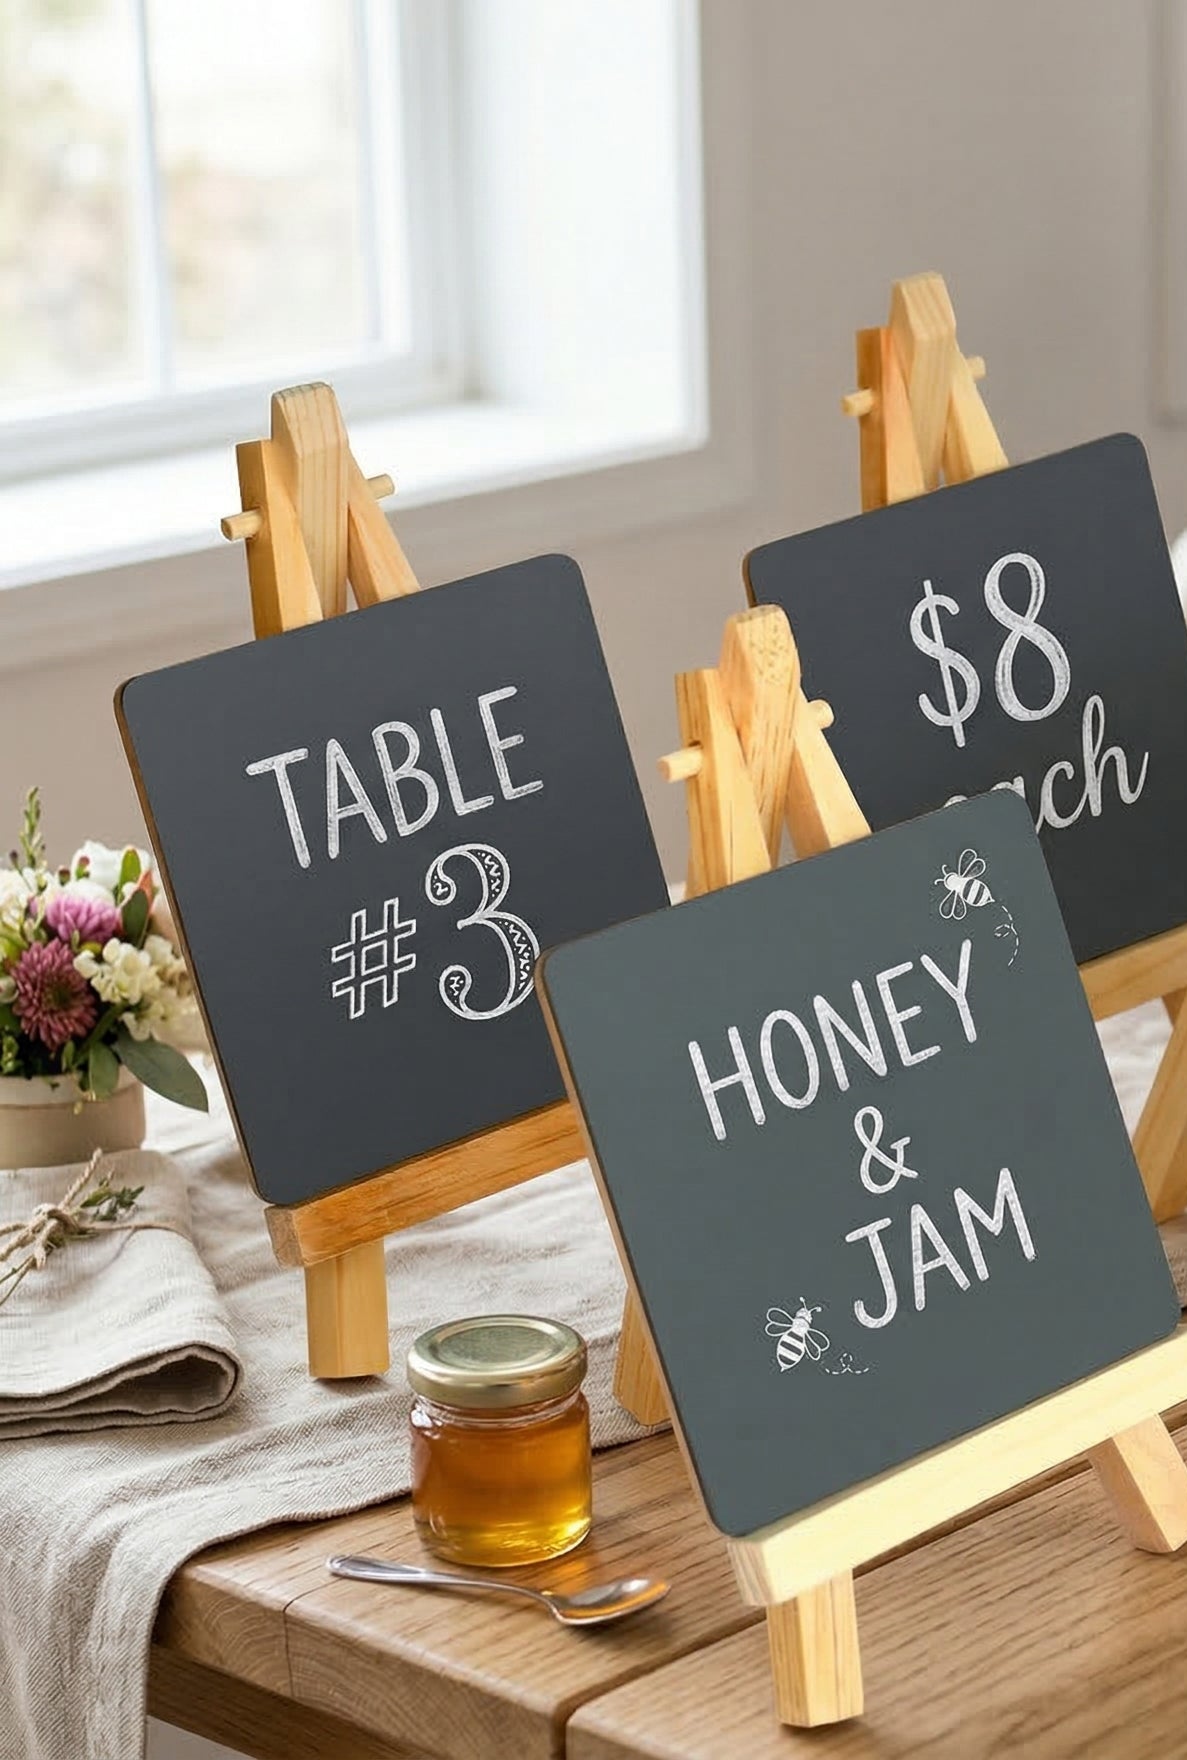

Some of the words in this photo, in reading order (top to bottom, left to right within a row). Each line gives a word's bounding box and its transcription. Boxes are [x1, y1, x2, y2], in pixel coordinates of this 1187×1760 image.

[910, 552, 1071, 748] $8
[246, 686, 544, 868] TABLE
[331, 843, 540, 1020] #3
[688, 939, 977, 1141] HONEY
[853, 1105, 918, 1194] &
[845, 1168, 1037, 1328] JAM
